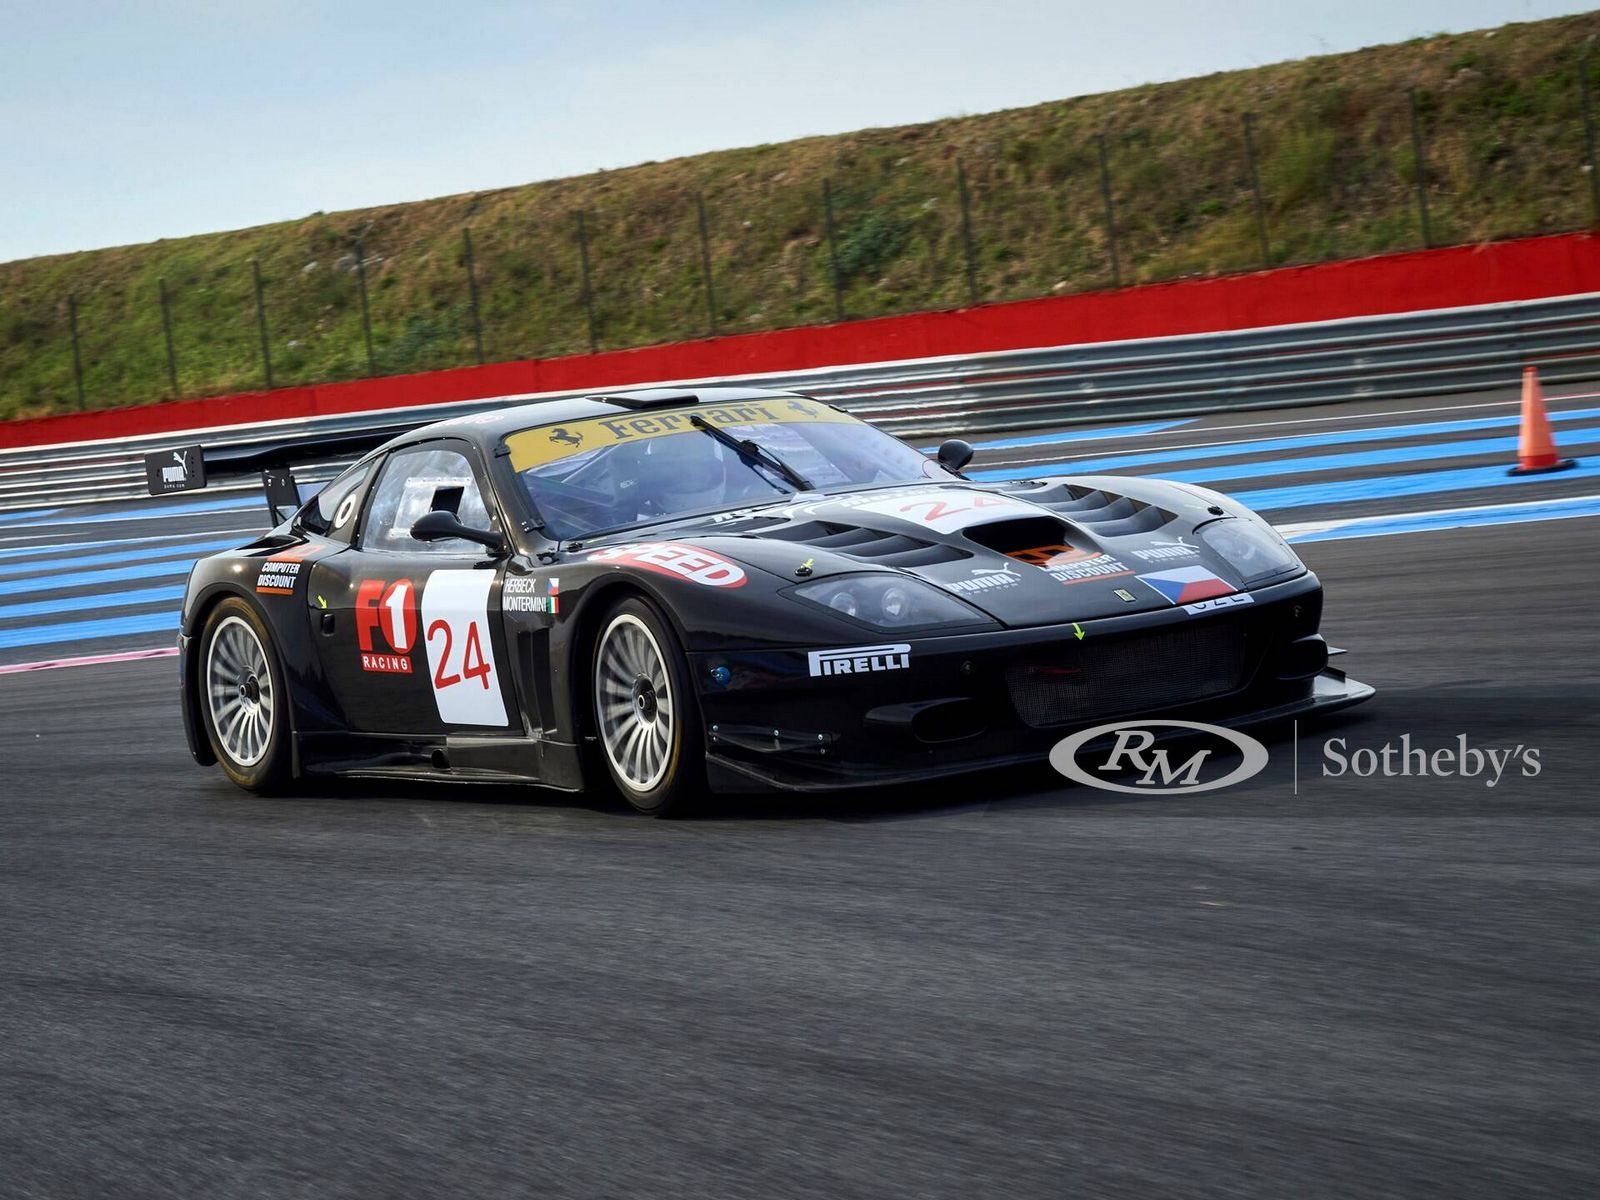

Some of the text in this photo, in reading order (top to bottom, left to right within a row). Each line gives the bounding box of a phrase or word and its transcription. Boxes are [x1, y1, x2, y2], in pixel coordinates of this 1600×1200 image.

[1131, 546, 1196, 560] PUMA
[261, 562, 301, 574] COMPUTER
[1050, 562, 1129, 582] DISCOUNT
[257, 574, 296, 588] DISCOUNT
[504, 578, 537, 593] HERBECK
[943, 574, 1016, 592] PUMA
[502, 596, 547, 612] MONTERMINI
[427, 619, 491, 690] 24
[808, 643, 911, 677] PIRELLI
[362, 655, 408, 670] RACING
